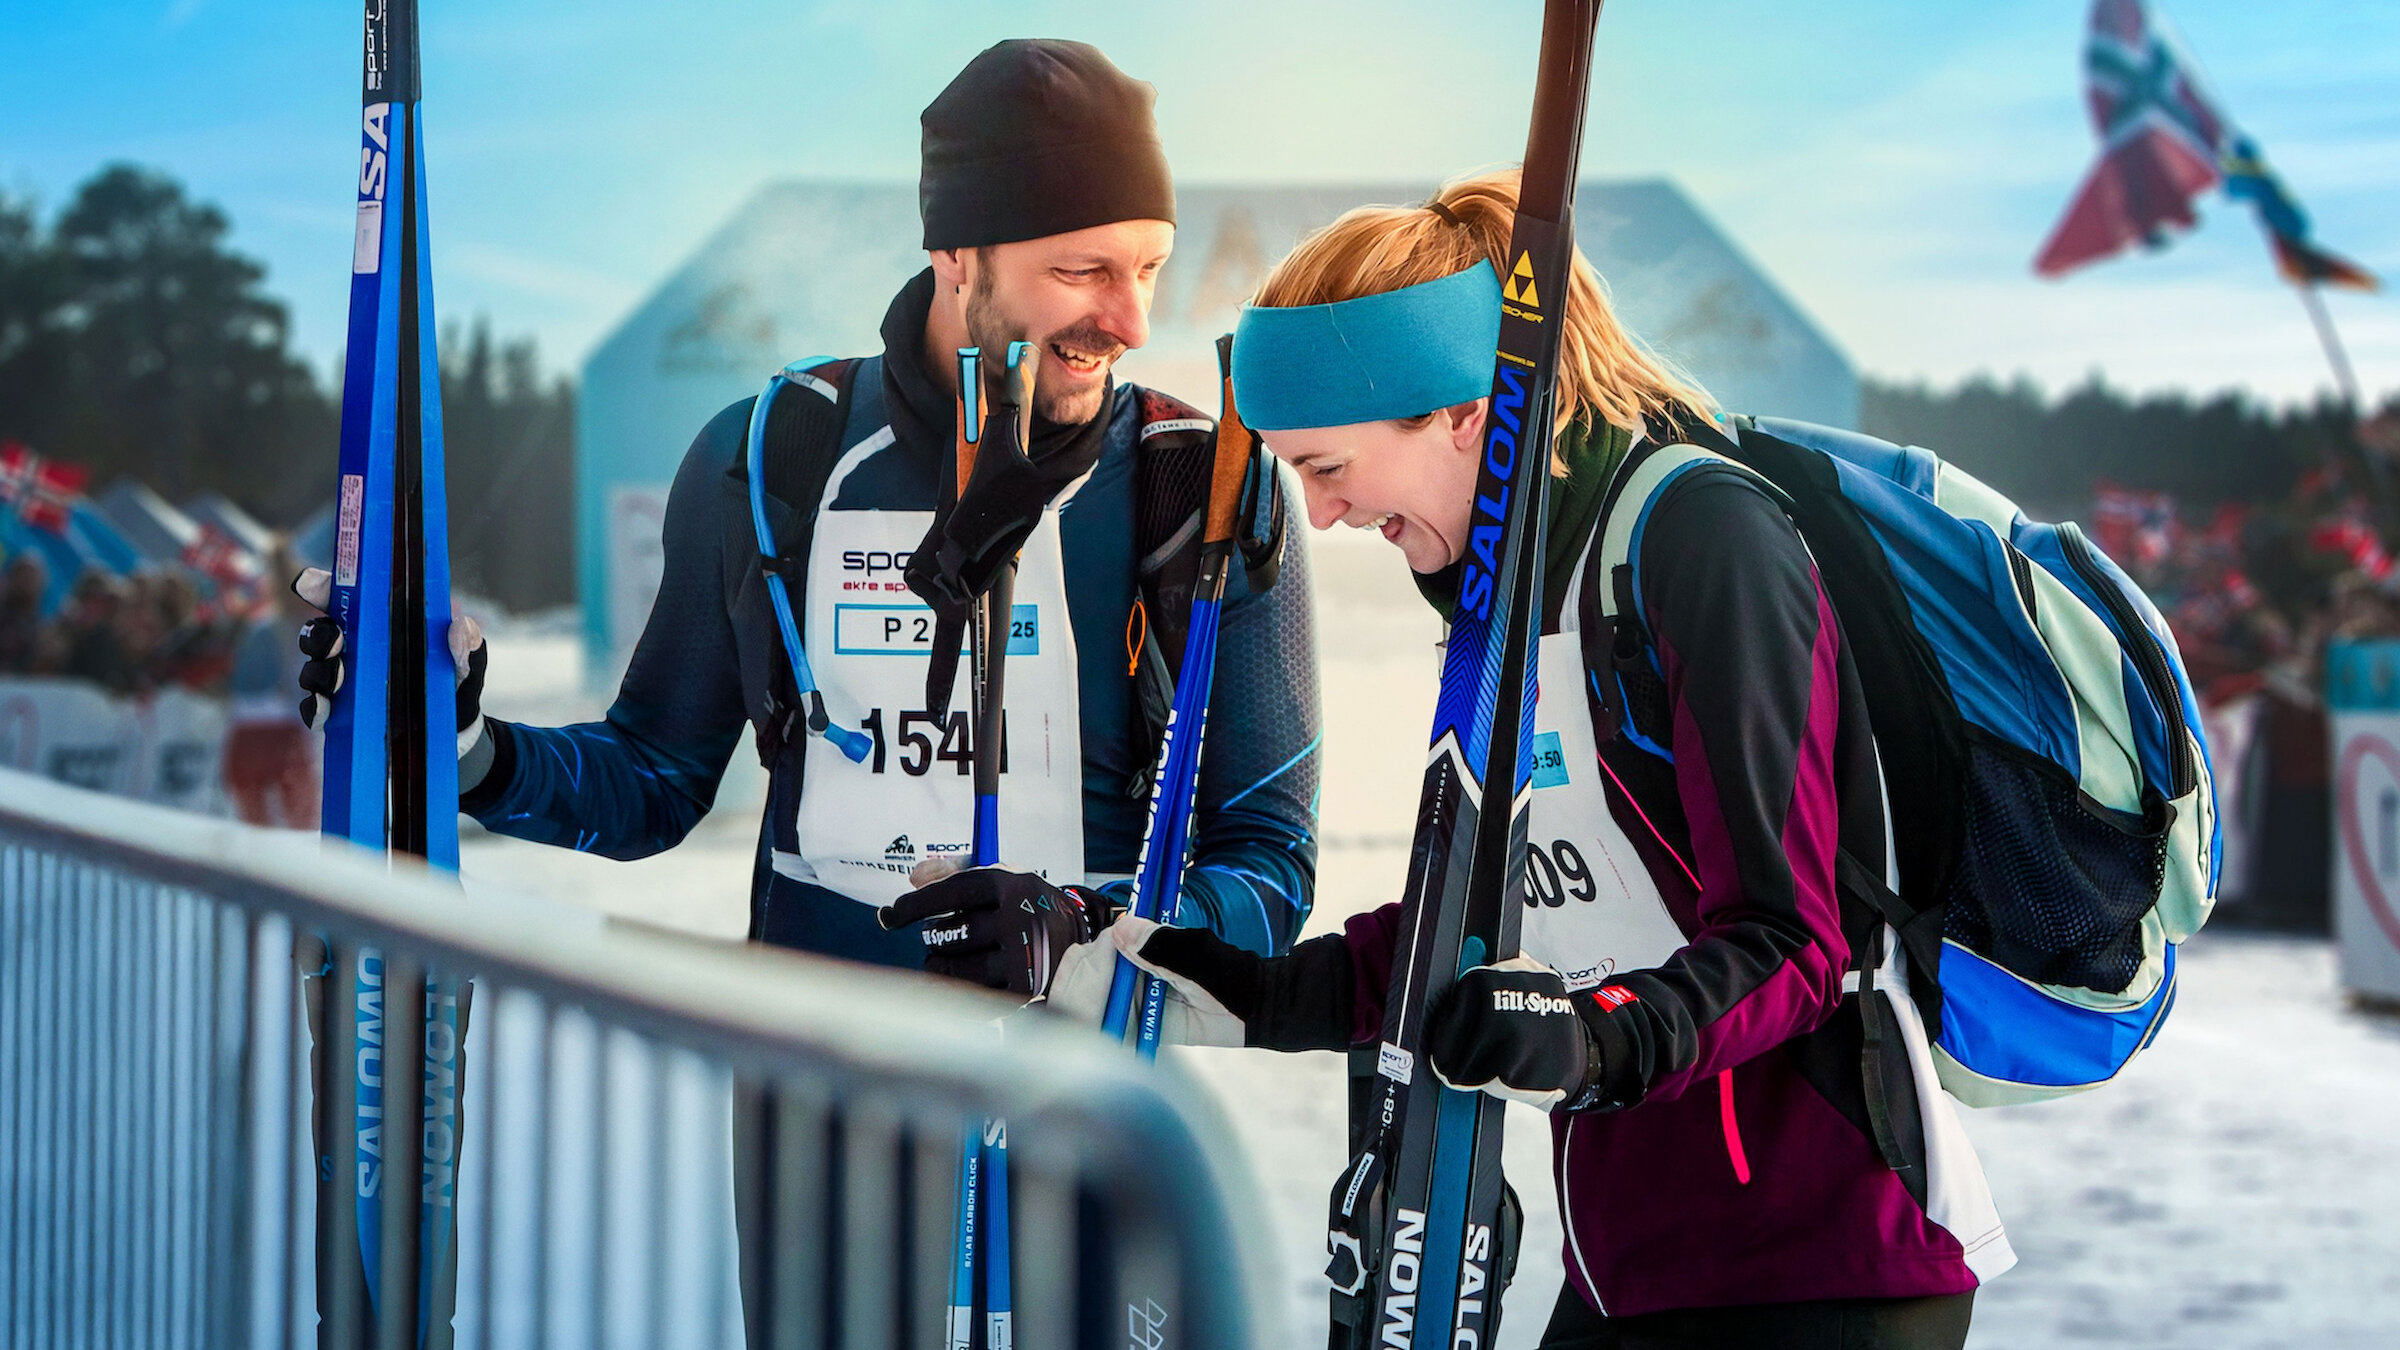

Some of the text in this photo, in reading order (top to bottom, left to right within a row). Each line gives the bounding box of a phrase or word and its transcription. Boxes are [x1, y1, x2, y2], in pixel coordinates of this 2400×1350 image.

[885, 617, 902, 642] P
[1566, 966, 1597, 981] port
[969, 1158, 977, 1187] CLICK
